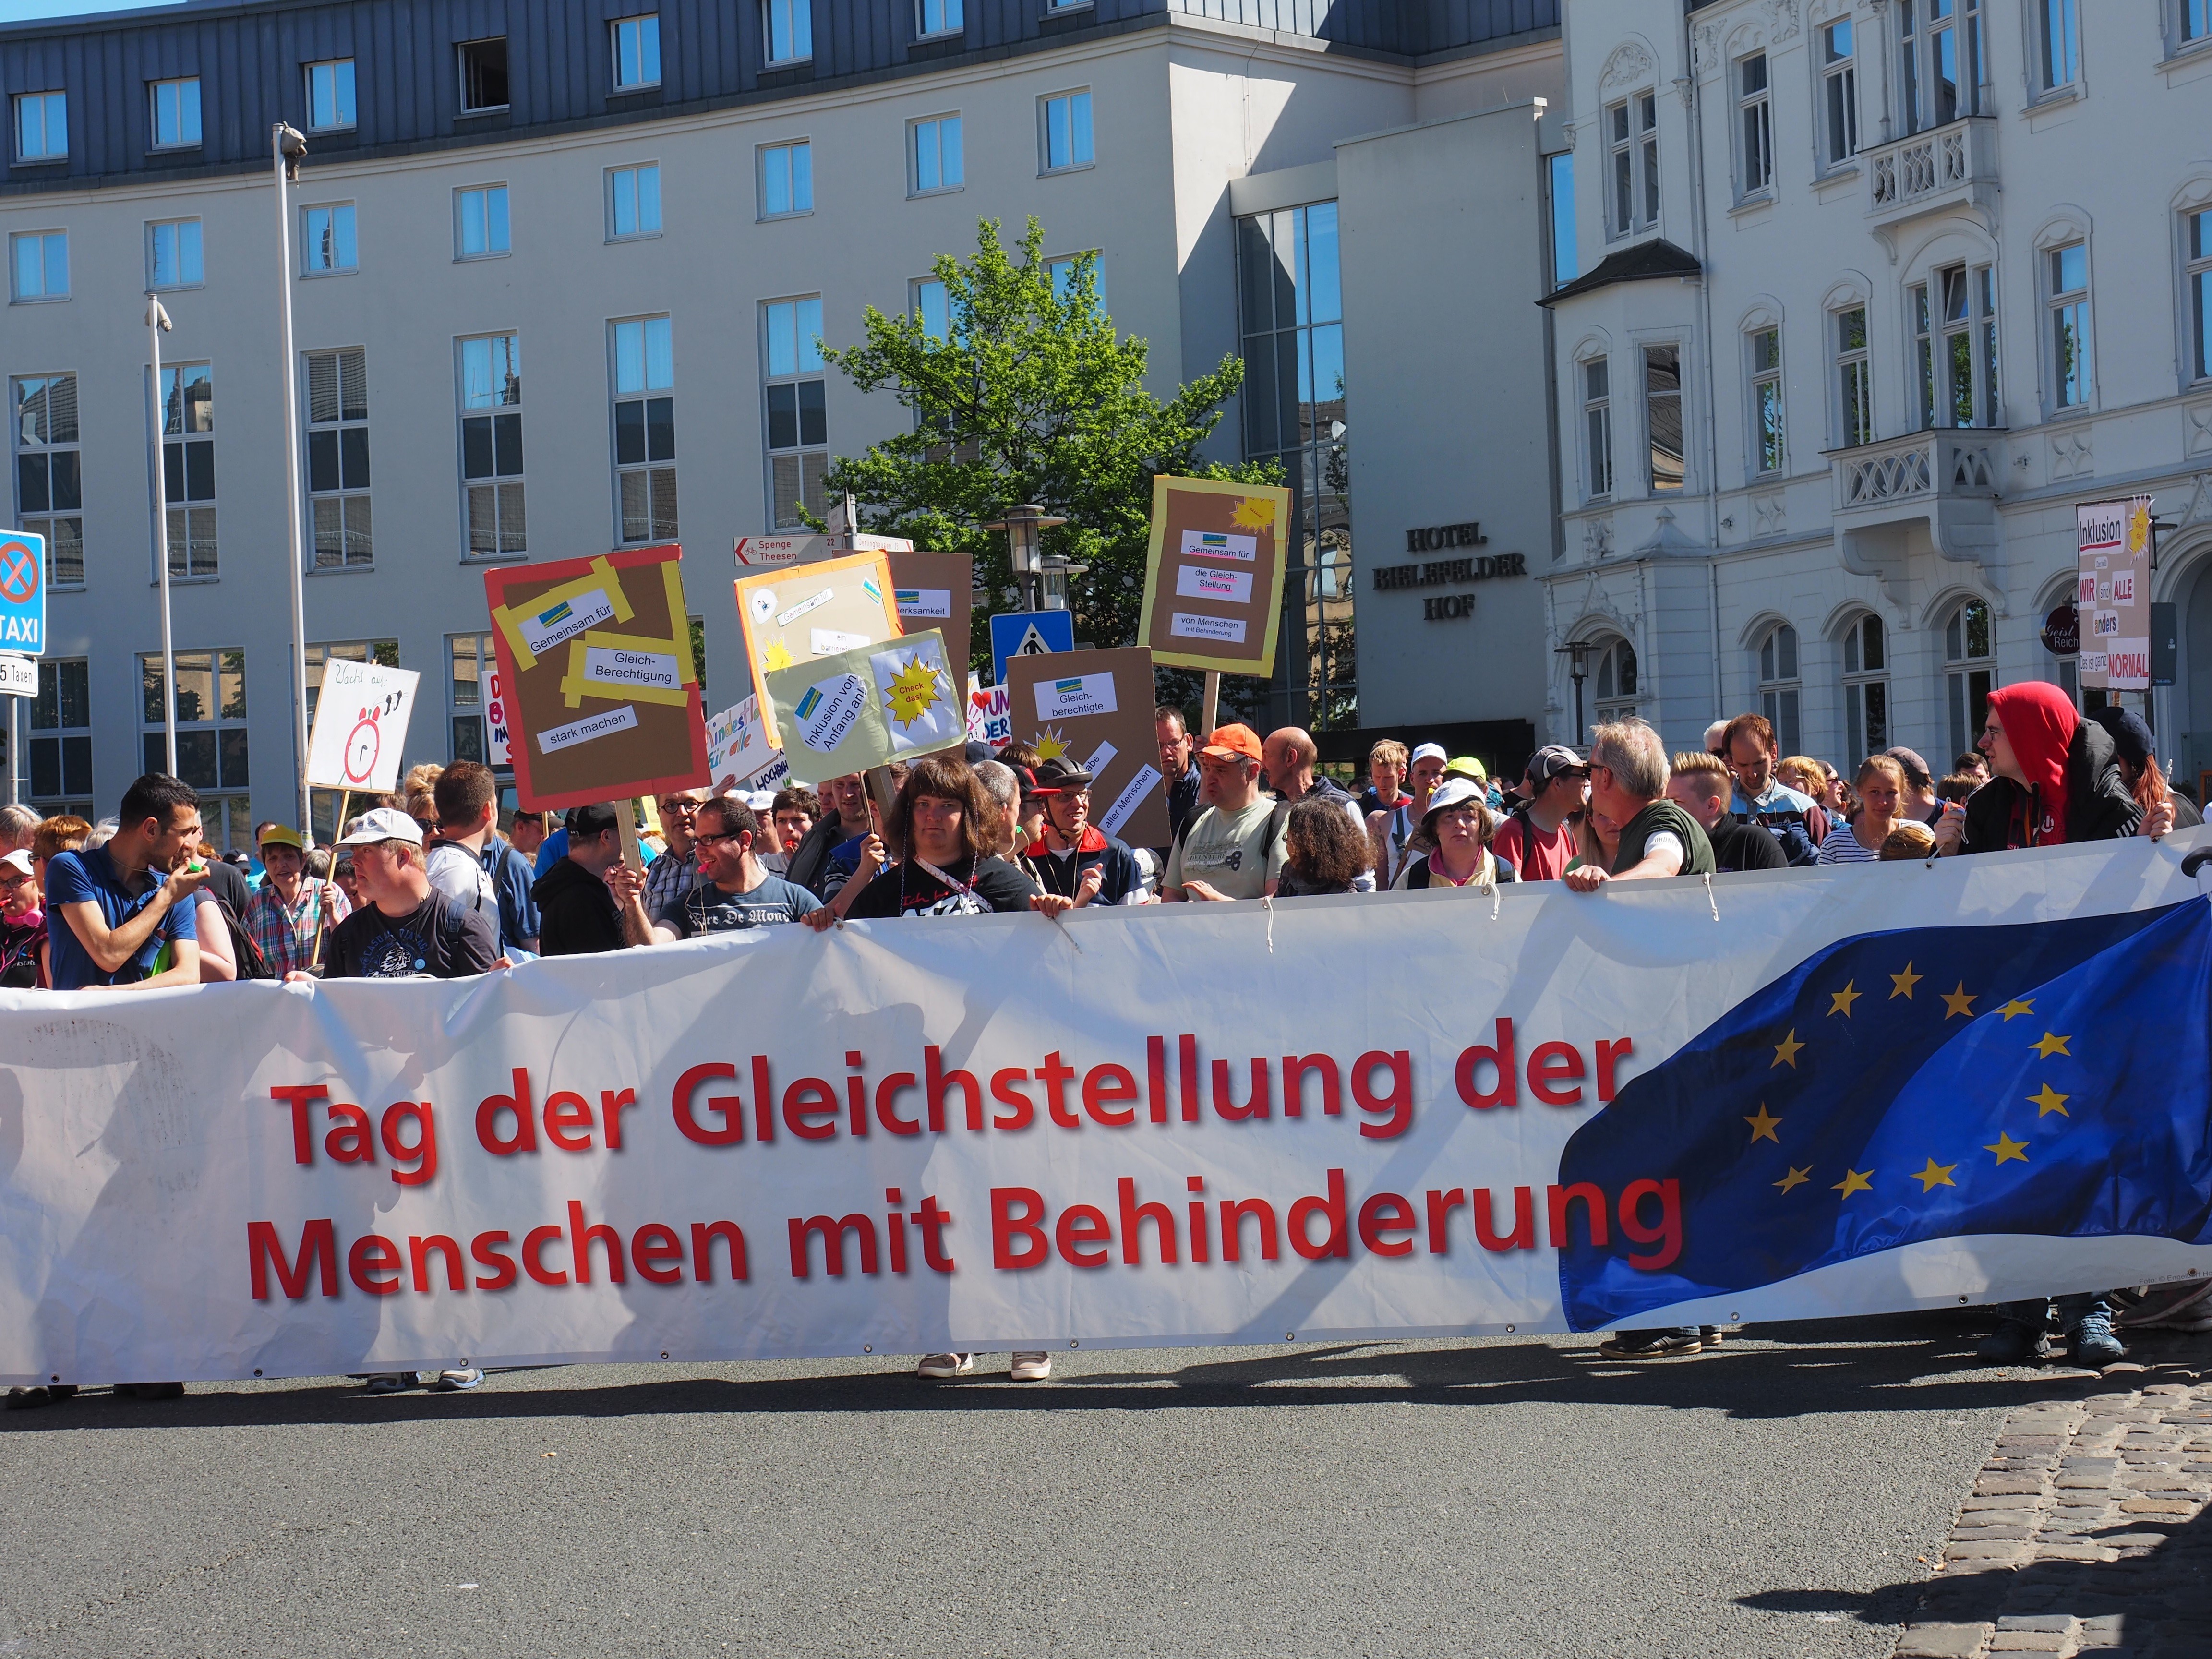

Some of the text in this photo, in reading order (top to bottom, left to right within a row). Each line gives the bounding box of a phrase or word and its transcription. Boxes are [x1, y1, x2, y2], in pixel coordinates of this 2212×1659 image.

[1406, 522, 1487, 552] HOTEL
[2080, 516, 2120, 545] Inklusion
[759, 538, 834, 551] Spenge 22
[1189, 545, 1236, 557] Gemeinsam
[760, 552, 797, 560] Theesen
[1210, 570, 1237, 580] Gleich-
[1372, 553, 1527, 590] BIELEFELDER
[1199, 580, 1231, 591] Stellung
[2080, 578, 2095, 602] WIR
[2114, 579, 2132, 600] ALLE
[783, 597, 820, 621] Gemeinsam
[1423, 594, 1476, 620] HOF
[0, 615, 38, 643] TAXI
[530, 614, 595, 652] Gemeinsam
[596, 605, 611, 618] für
[1196, 628, 1232, 637] Behinderung
[1198, 618, 1238, 629] Menschen
[2045, 624, 2075, 637] Geist
[2055, 637, 2079, 648] Reich
[615, 652, 656, 665] Gleich-
[2095, 654, 2107, 671] ganz
[2108, 653, 2149, 678] NORMAL
[12, 665, 32, 684] Taxen
[336, 664, 364, 684] Wacht
[596, 665, 672, 684] Berechtigung
[899, 683, 924, 694] Check
[906, 693, 922, 703] das!
[1060, 692, 1093, 703] Gleich-
[805, 697, 842, 746] Inklusion
[839, 674, 856, 696] von
[824, 687, 867, 751] Anfang an!
[1052, 702, 1104, 717] berechtigte
[550, 714, 626, 744] stark machen
[729, 727, 751, 756] alle
[1105, 769, 1152, 828] aller Menschen
[270, 1018, 1632, 1185] Tag der Gleichstellung der
[247, 1169, 1682, 1300] Menschen mit Behinderung
[2167, 1273, 2200, 1281] Engelbrt
